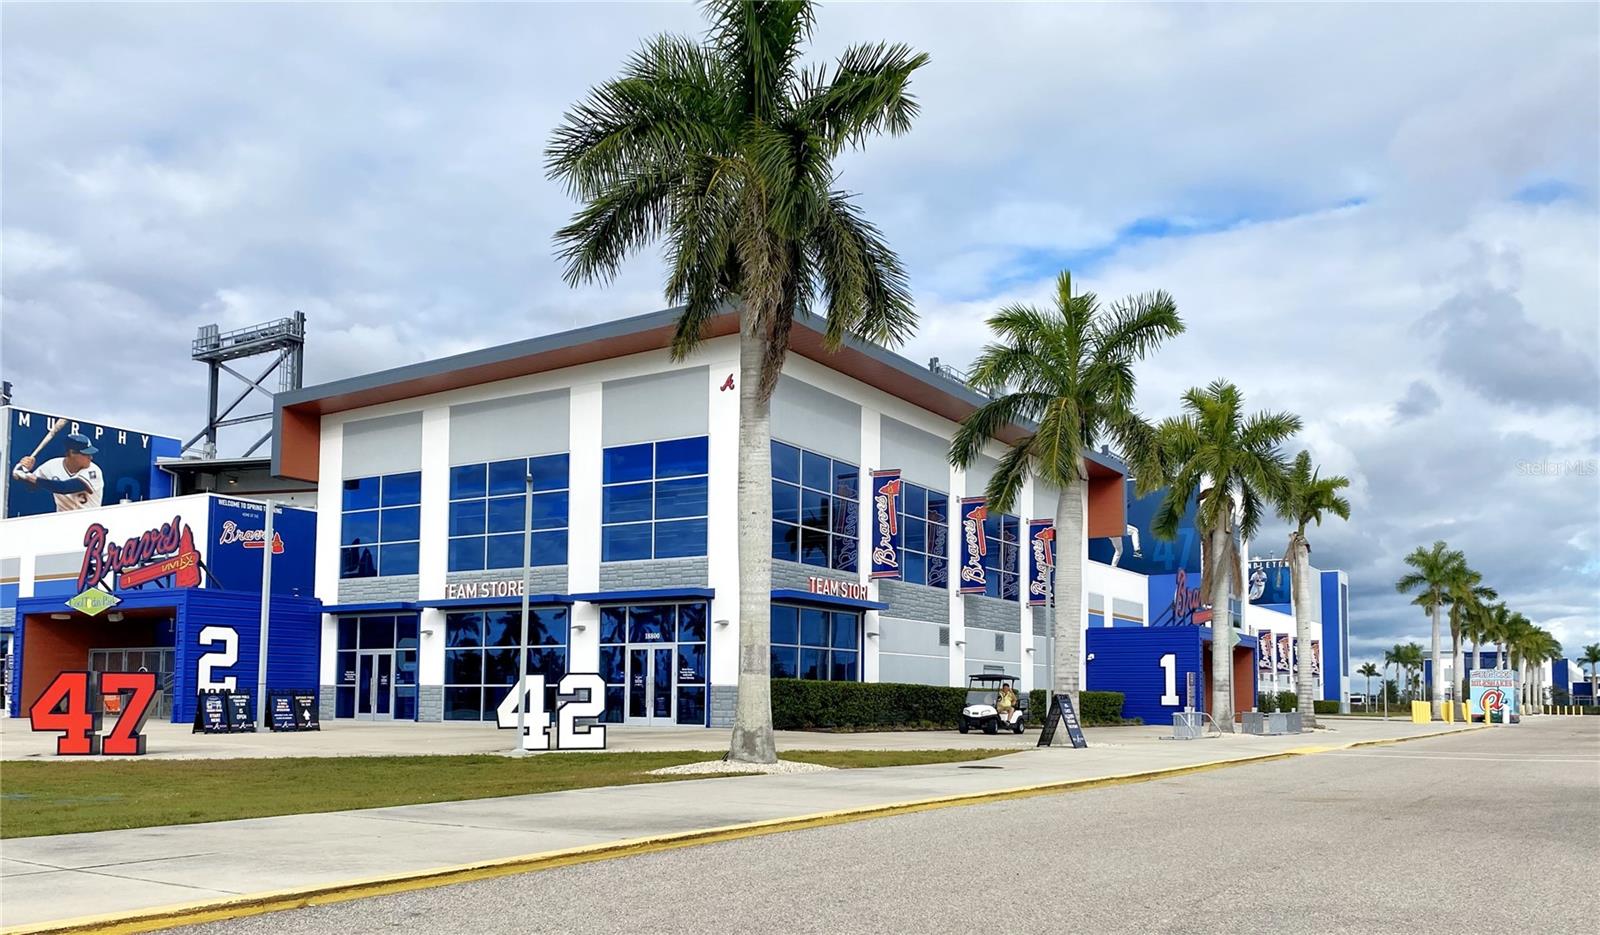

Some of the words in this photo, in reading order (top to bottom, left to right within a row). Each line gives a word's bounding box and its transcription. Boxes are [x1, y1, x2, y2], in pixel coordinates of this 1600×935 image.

[18, 411, 149, 449] MURPHY
[218, 499, 240, 508] WELCOME
[873, 495, 899, 568] Braves
[77, 515, 182, 593] Braves
[962, 520, 986, 584] Braves
[1030, 540, 1053, 597] Braves
[443, 583, 478, 599] TEAM
[808, 576, 839, 597] TEAM
[198, 625, 239, 693] 2
[1159, 653, 1180, 706] 1
[30, 671, 157, 756] 47
[496, 672, 607, 750] 42
